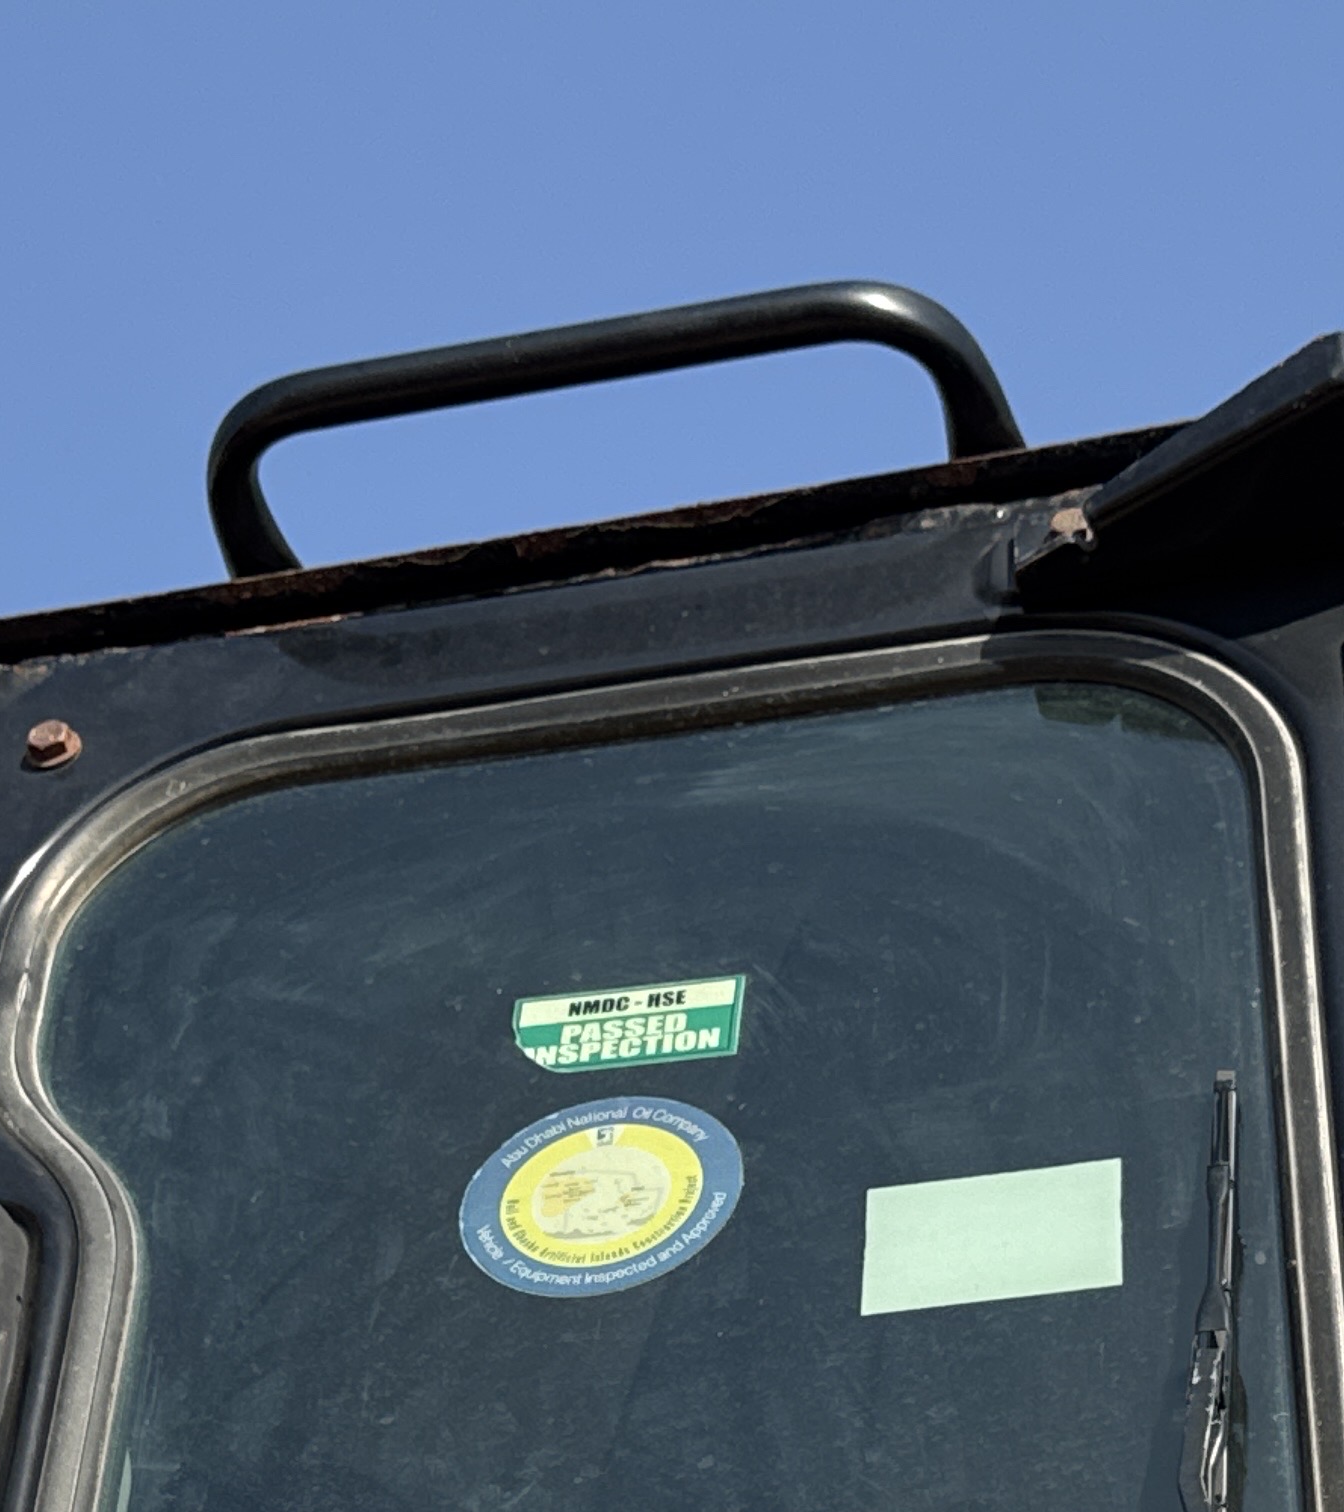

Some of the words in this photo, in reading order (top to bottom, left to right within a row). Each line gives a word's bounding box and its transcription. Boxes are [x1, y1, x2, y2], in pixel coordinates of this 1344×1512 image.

[568, 996, 630, 1017] NMDC
[647, 989, 687, 1008] HSE
[560, 1012, 687, 1045] PASSED
[500, 1145, 529, 1169] Abu
[523, 1121, 567, 1149] Dhabi
[566, 1106, 629, 1128] National
[632, 1106, 653, 1120] Oil
[652, 1108, 710, 1142] Company
[509, 1260, 582, 1286] Equipment
[583, 1254, 657, 1285] Inspected
[657, 1239, 685, 1262] and
[681, 1191, 727, 1246] Approved
